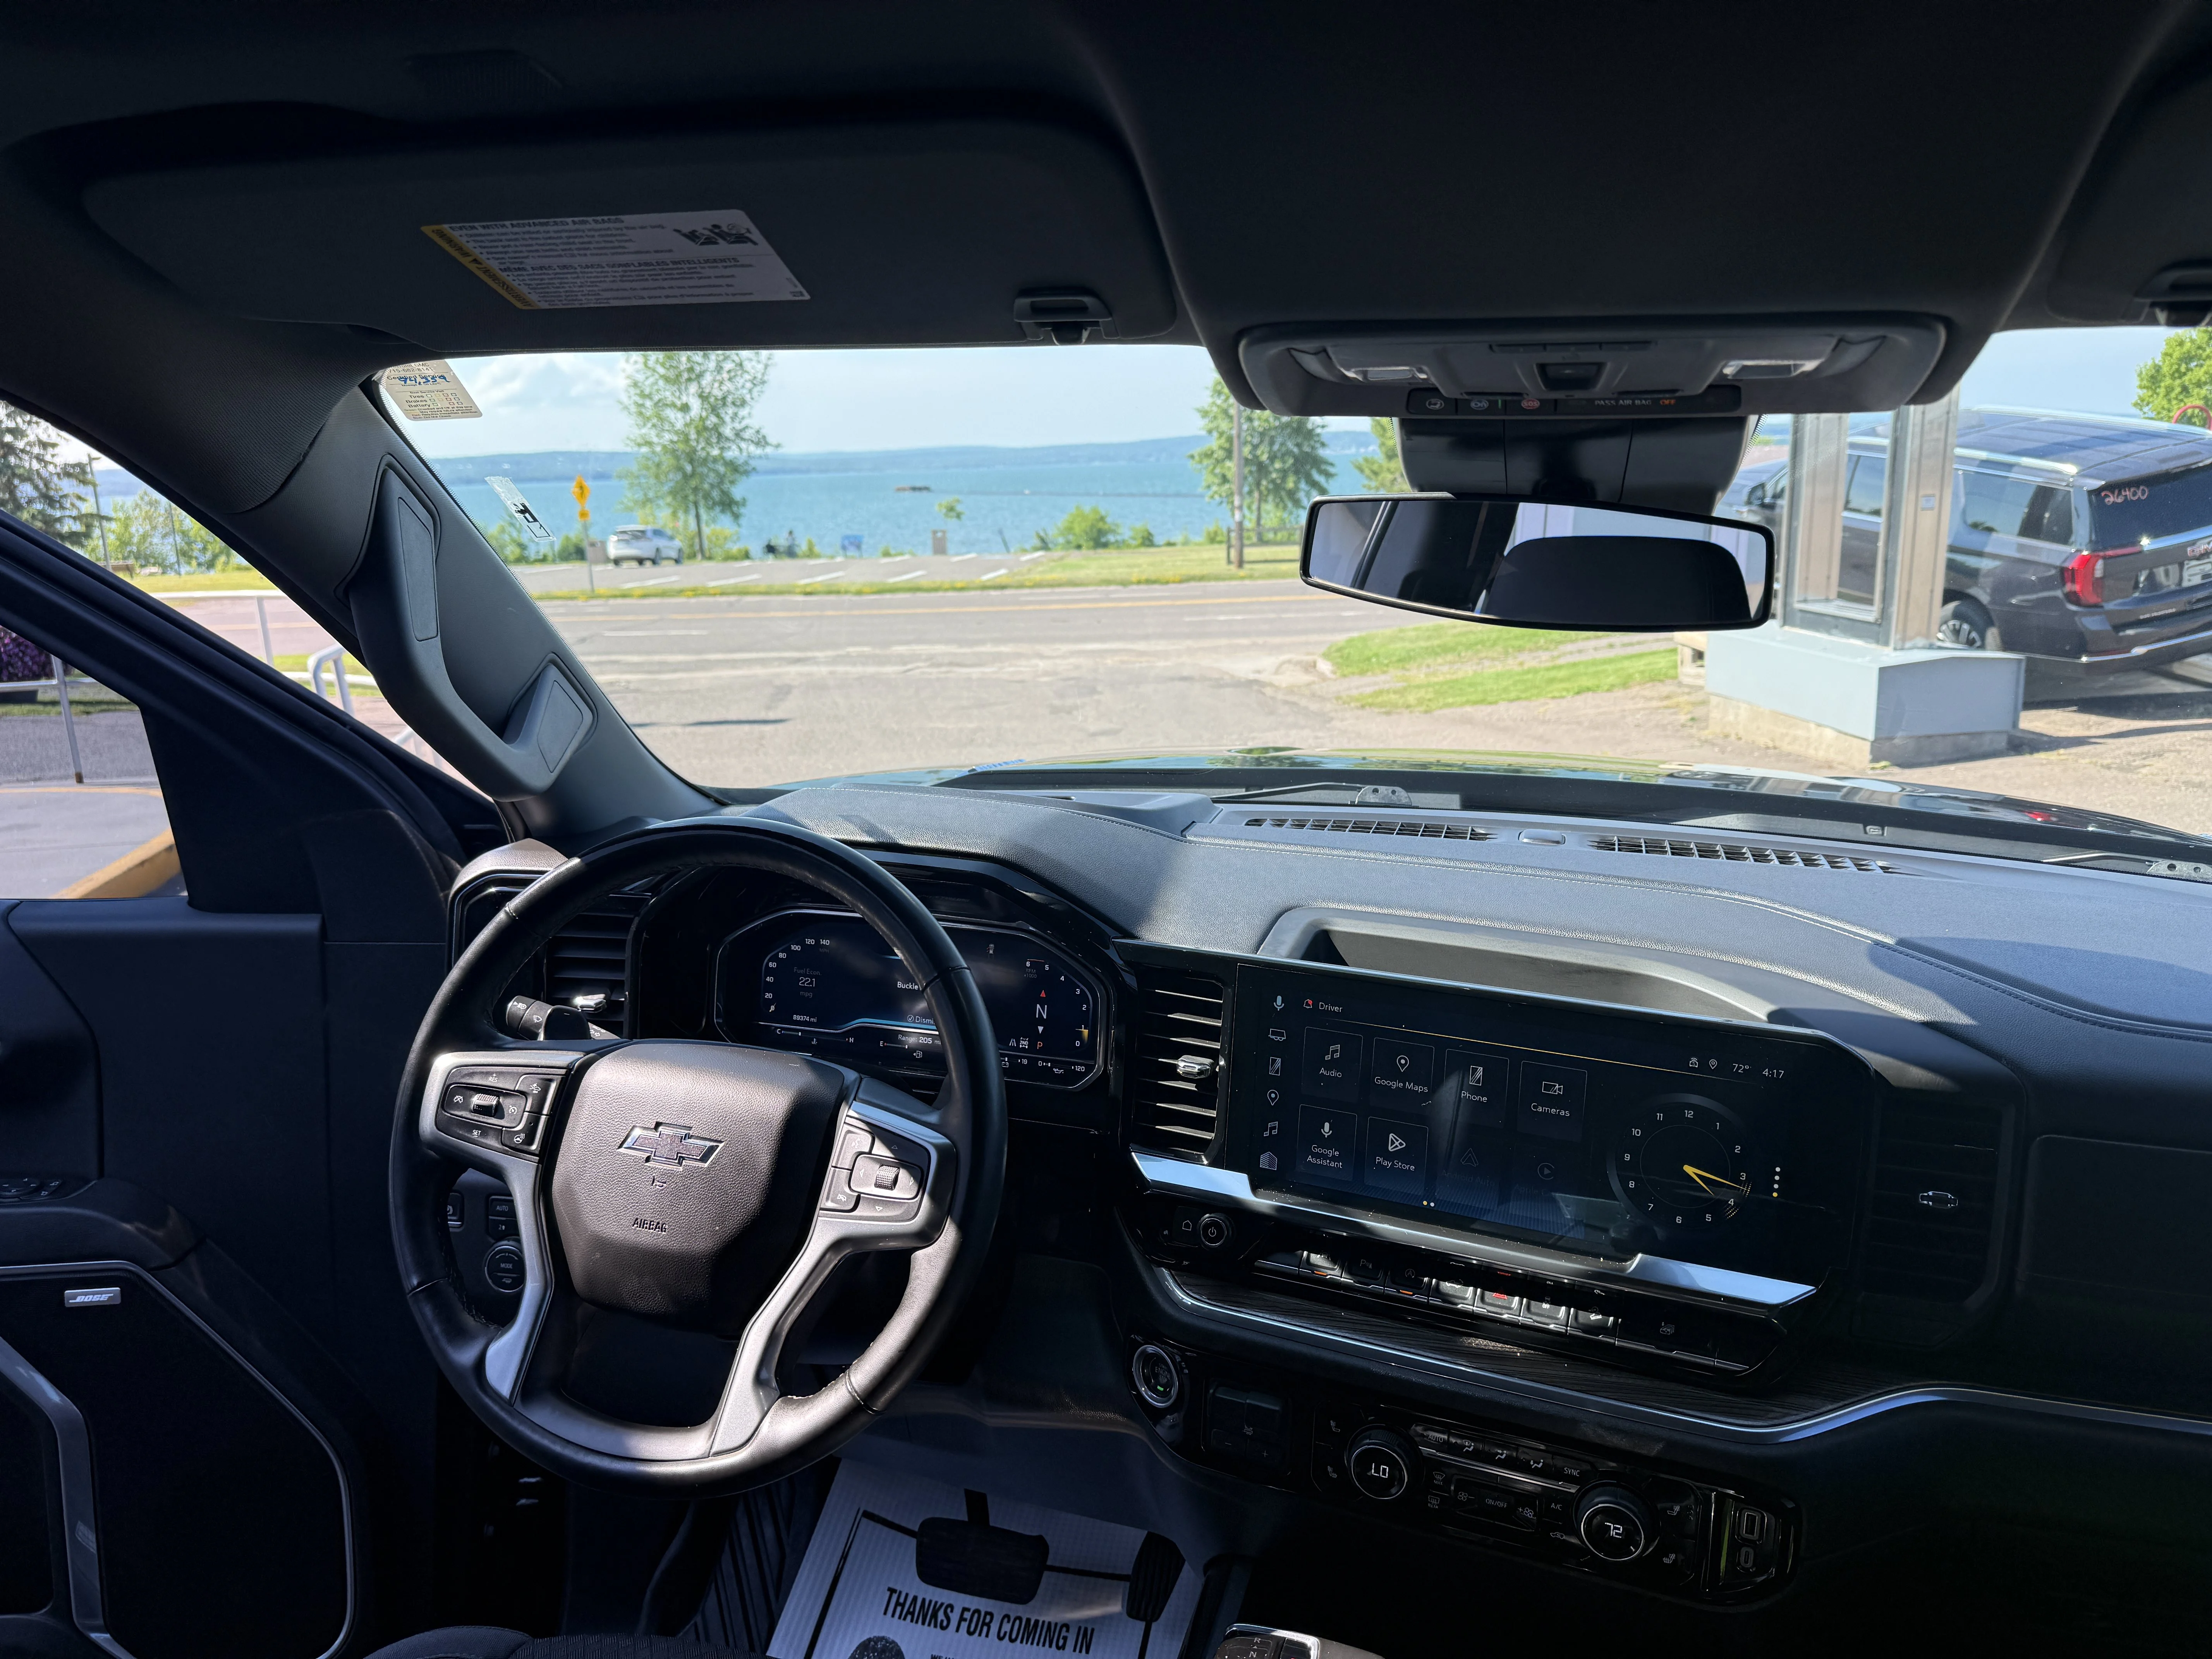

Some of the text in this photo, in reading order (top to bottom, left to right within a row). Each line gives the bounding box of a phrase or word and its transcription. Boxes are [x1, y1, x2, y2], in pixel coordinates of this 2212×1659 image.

[510, 220, 570, 228] ADVANCED
[670, 257, 740, 266] INTELLIGENTS
[2102, 485, 2149, 505] 26400
[799, 977, 816, 987] 22.1
[897, 981, 919, 990] Buckle
[1036, 1004, 1047, 1019] N
[1319, 1001, 1343, 1013] Driver
[898, 1034, 917, 1042] Range:
[1037, 1041, 1043, 1049] P
[1319, 1067, 1342, 1079] Audio
[1762, 1068, 1784, 1080] 4:17
[1374, 1076, 1429, 1093] Google Maps
[1461, 1091, 1488, 1103] Phone
[1531, 1103, 1570, 1117] Cameras
[1684, 1110, 1694, 1118] 12
[1656, 1113, 1664, 1121] 11
[1716, 1122, 1720, 1130] 1
[1632, 1128, 1642, 1137] 10
[1311, 1144, 1340, 1158] Google
[1306, 1155, 1343, 1169] Assistant
[1376, 1156, 1415, 1171] Play Store
[1648, 1203, 1654, 1211] 7
[632, 1217, 668, 1233] AIRBAG
[1676, 1216, 1682, 1224] 6
[69, 1293, 114, 1303] BOSE
[1428, 1434, 1444, 1443] AUTO
[1563, 1467, 1581, 1477] SYNC
[1486, 1498, 1508, 1509] ON/OFF
[1551, 1503, 1563, 1511] A/C
[1604, 1522, 1623, 1538] 72
[883, 1586, 1095, 1655] THANKS FOR COMING IN
